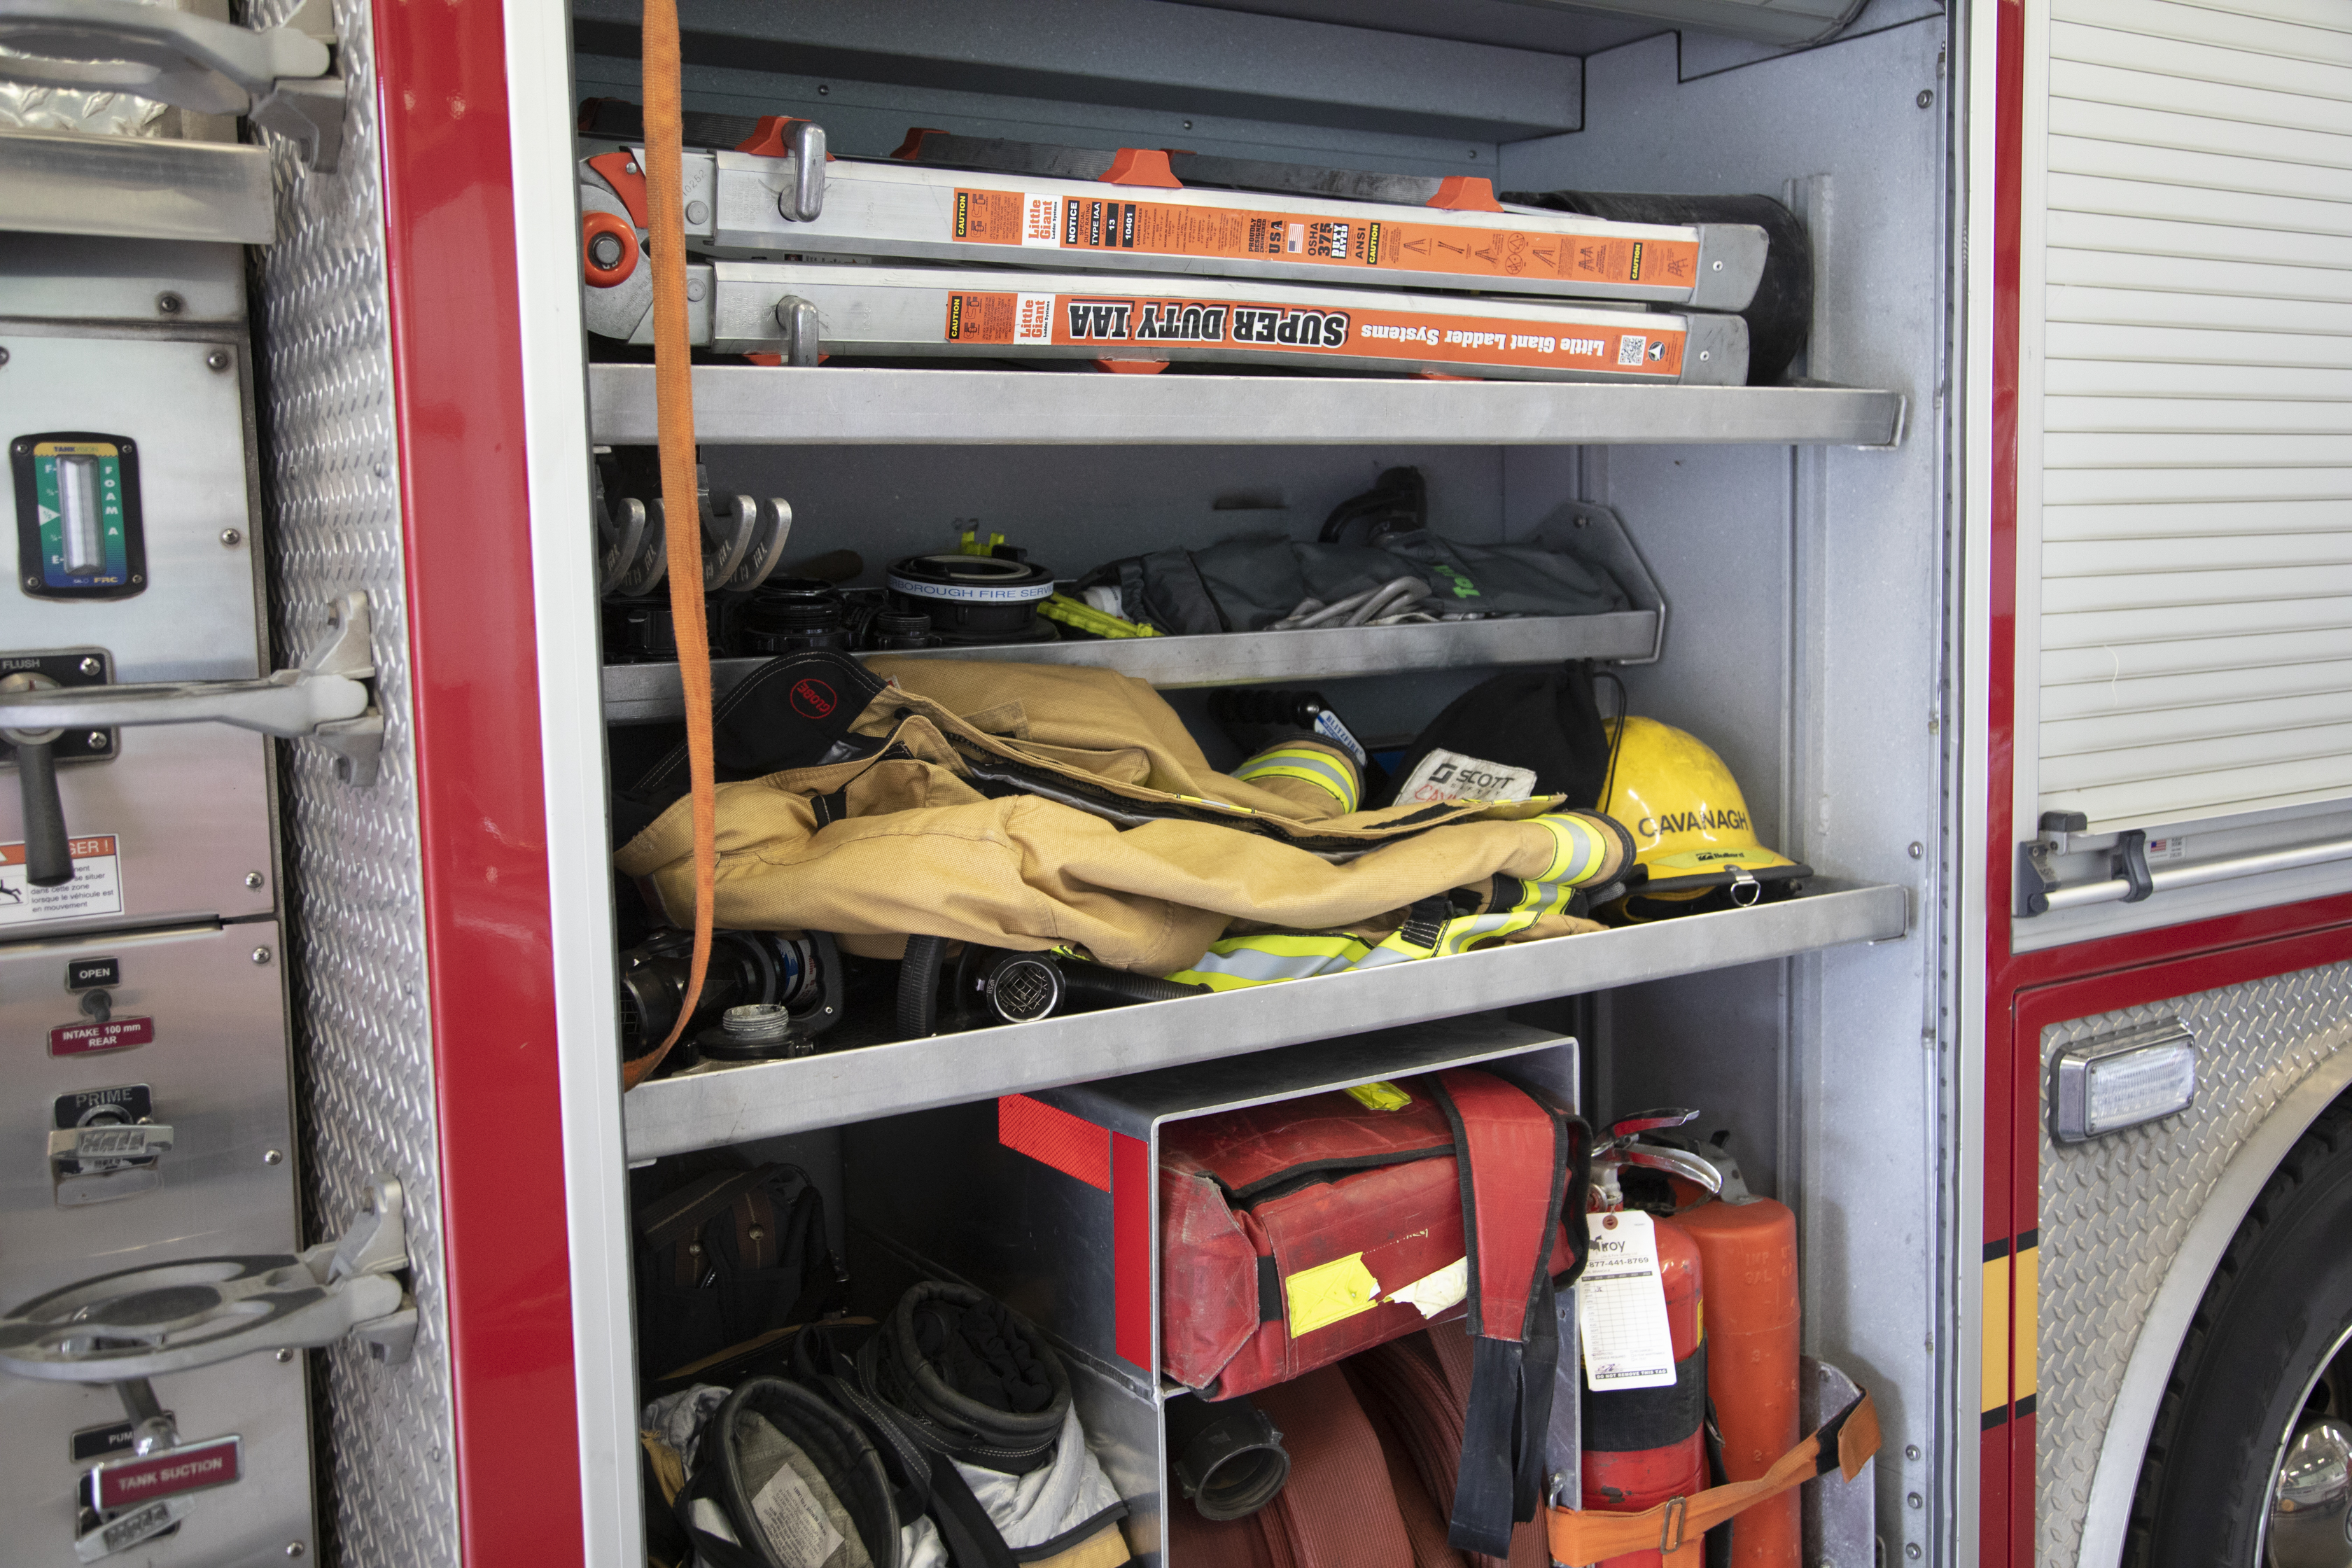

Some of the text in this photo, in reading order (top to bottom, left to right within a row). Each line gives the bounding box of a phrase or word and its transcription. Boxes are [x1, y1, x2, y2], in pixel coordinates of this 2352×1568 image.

[958, 195, 966, 235] CAUTION
[1028, 199, 1041, 239] Little
[1039, 200, 1052, 239] Giant
[1068, 201, 1077, 242] NOTICE
[1108, 218, 1115, 230] 13
[1124, 212, 1133, 240] 10401
[1248, 217, 1256, 252] PROUDLY
[1268, 219, 1282, 253] USA
[1307, 221, 1319, 256] OSHA
[1317, 222, 1333, 256] 375
[1331, 224, 1341, 257] DUTY
[1338, 225, 1348, 258] RATED
[1354, 227, 1366, 260] ANSI
[1368, 224, 1378, 263] CAUTION
[1632, 244, 1641, 279] CAUTION
[951, 298, 960, 337] CAUTION
[1019, 299, 1034, 338] Little
[1030, 300, 1045, 338] Giant
[1068, 300, 1349, 349] SUPER DUTY IAA
[1361, 323, 1440, 346] Systems
[1444, 330, 1507, 350] Ladder
[1510, 334, 1556, 355] Giant
[1560, 337, 1606, 357] Little
[45, 465, 52, 473] F
[104, 466, 118, 515] FOAM
[108, 527, 119, 536] A
[52, 555, 59, 564] E
[979, 590, 1016, 598] FIRE
[2, 659, 40, 669] FLUSH
[797, 682, 831, 713] GLOBE
[1456, 769, 1516, 789] SCOTT
[1638, 809, 1749, 838] CAVANAGH
[31, 895, 59, 905] lorsque
[71, 890, 100, 899] véhicule
[44, 902, 88, 911] mouvement
[79, 967, 111, 979] OPEN
[62, 1023, 141, 1041] INTAKE 100 mm
[88, 1035, 117, 1048] REAR
[75, 1088, 133, 1108] PRIME
[1586, 1256, 1648, 1268] -877-441-8769
[108, 1432, 134, 1446] PUM
[118, 1457, 223, 1492] TANK SUCTION
